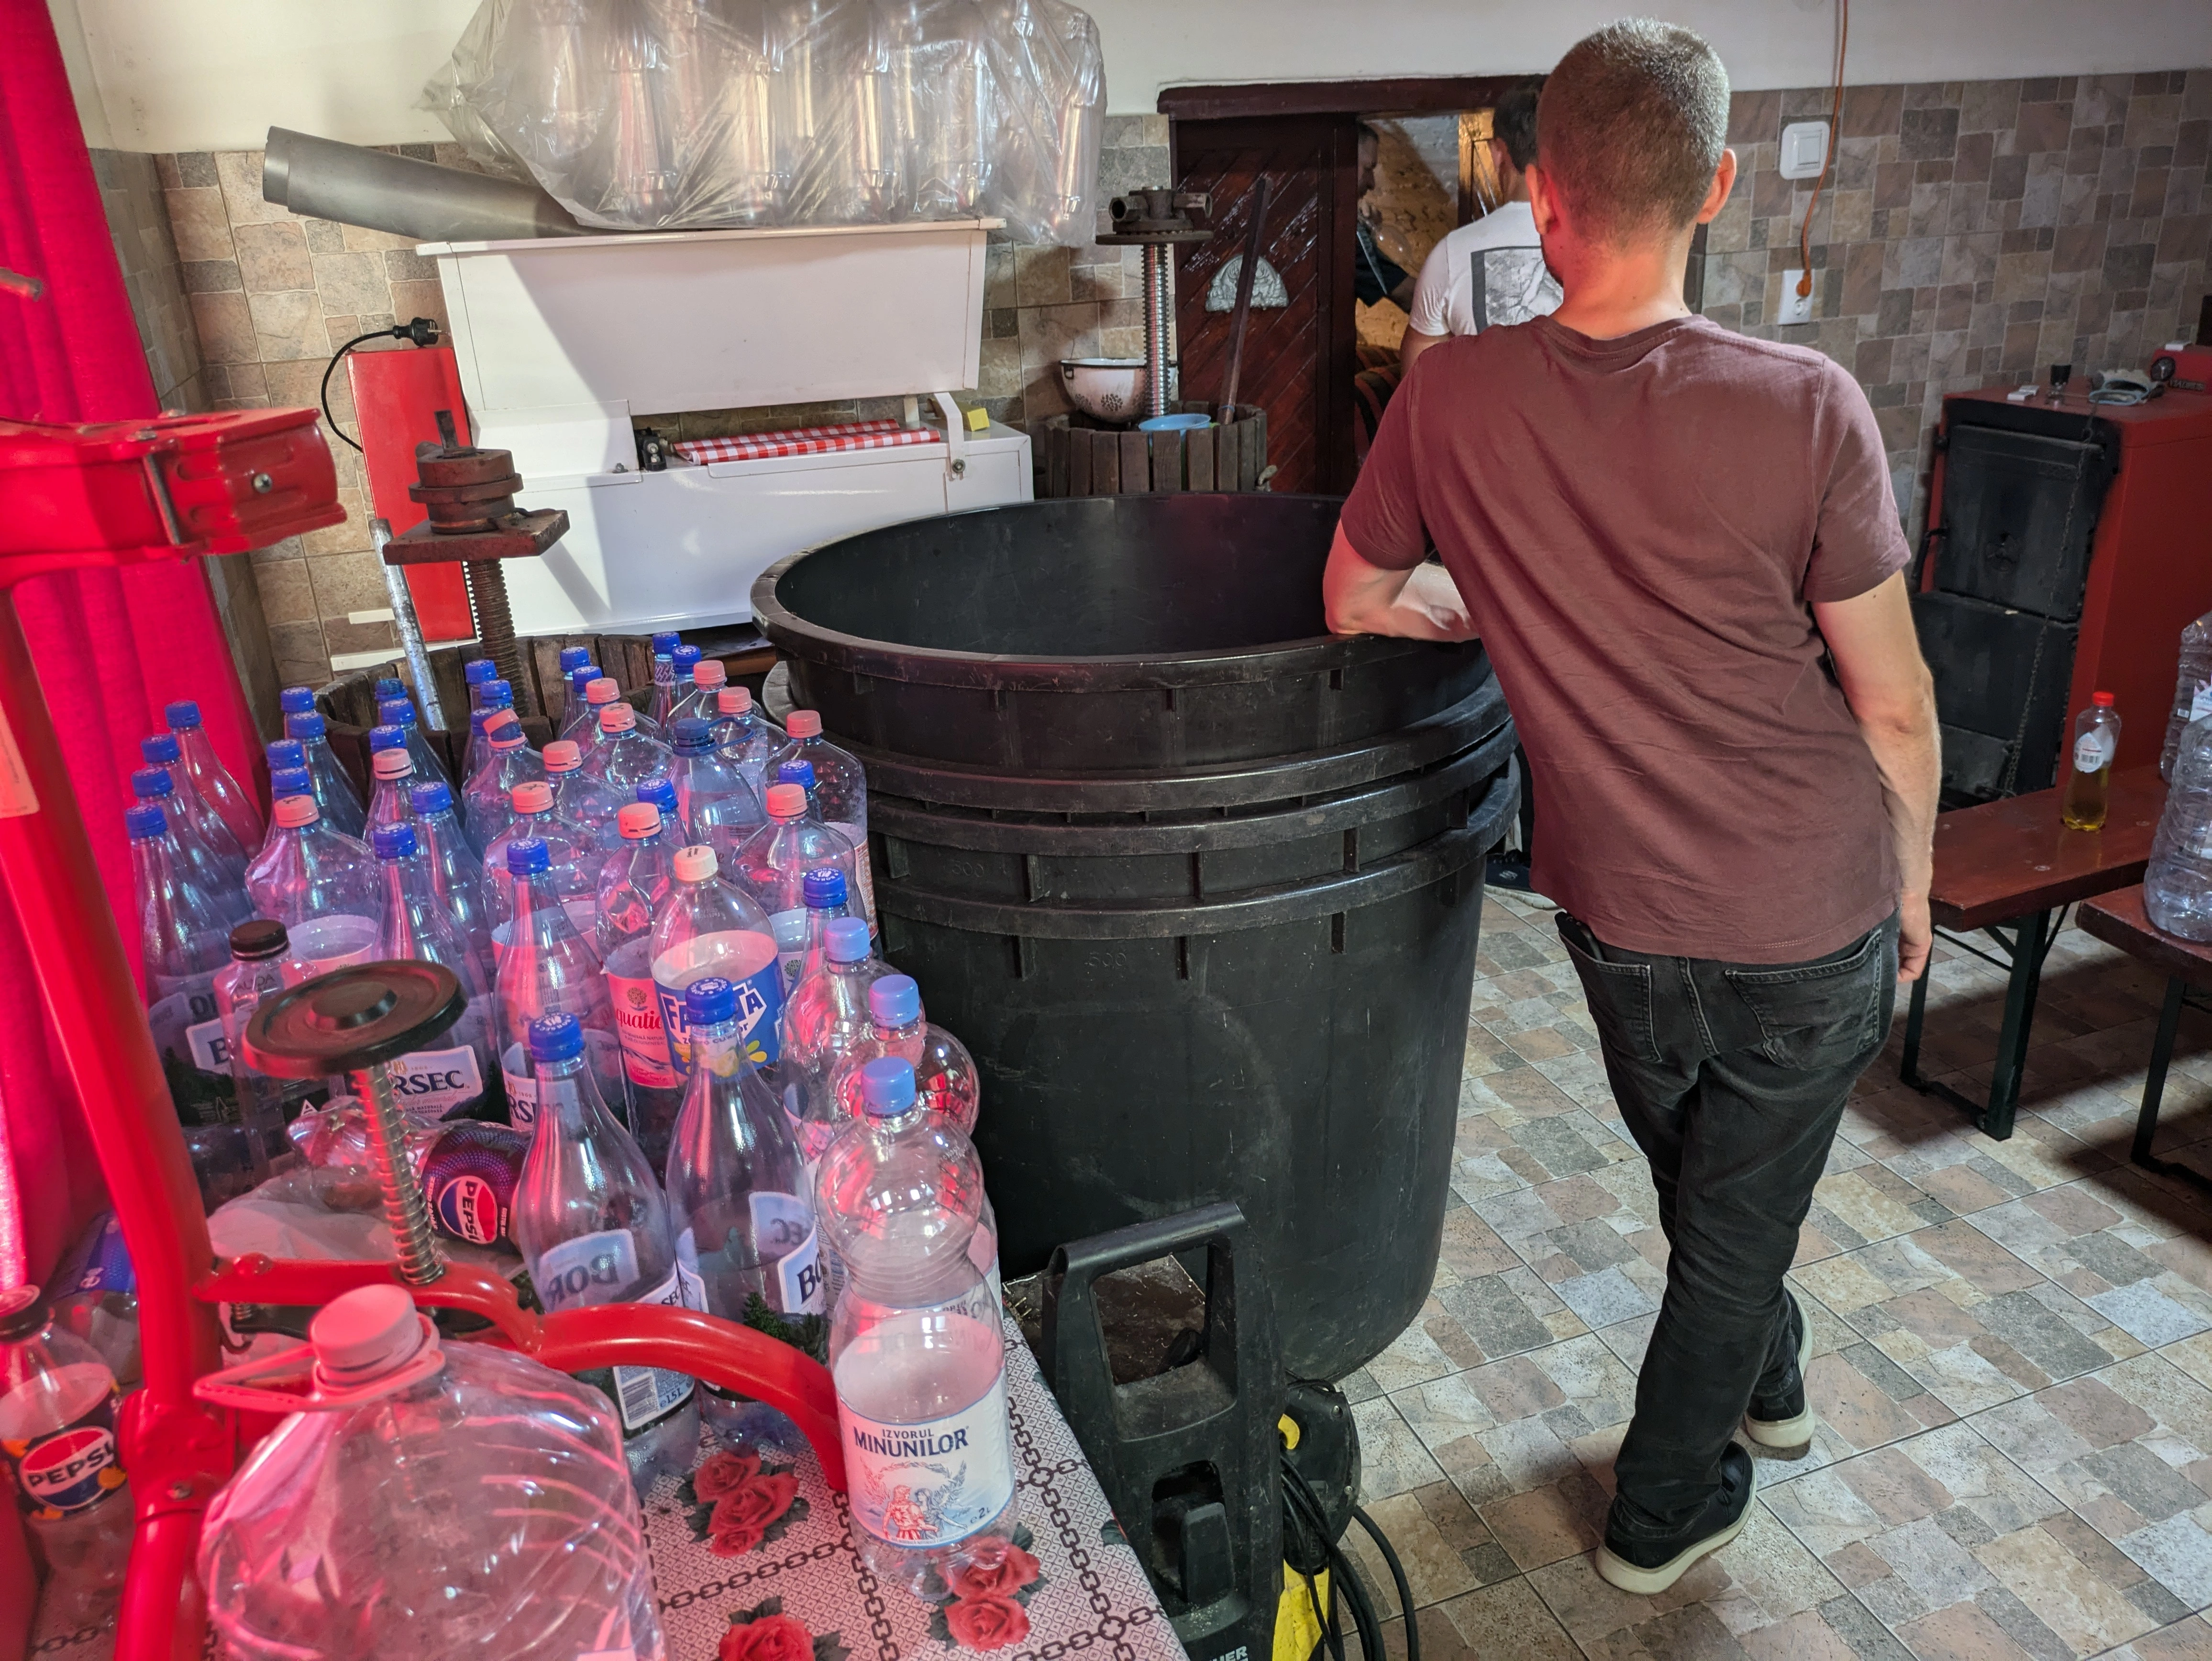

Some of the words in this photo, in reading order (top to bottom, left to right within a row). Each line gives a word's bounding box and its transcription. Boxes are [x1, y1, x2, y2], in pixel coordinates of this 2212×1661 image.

[393, 1070, 465, 1096] RSEC
[462, 1180, 481, 1240] PEPSI
[853, 1426, 969, 1457] MINUNILOR
[883, 1428, 934, 1439] IZVORUL
